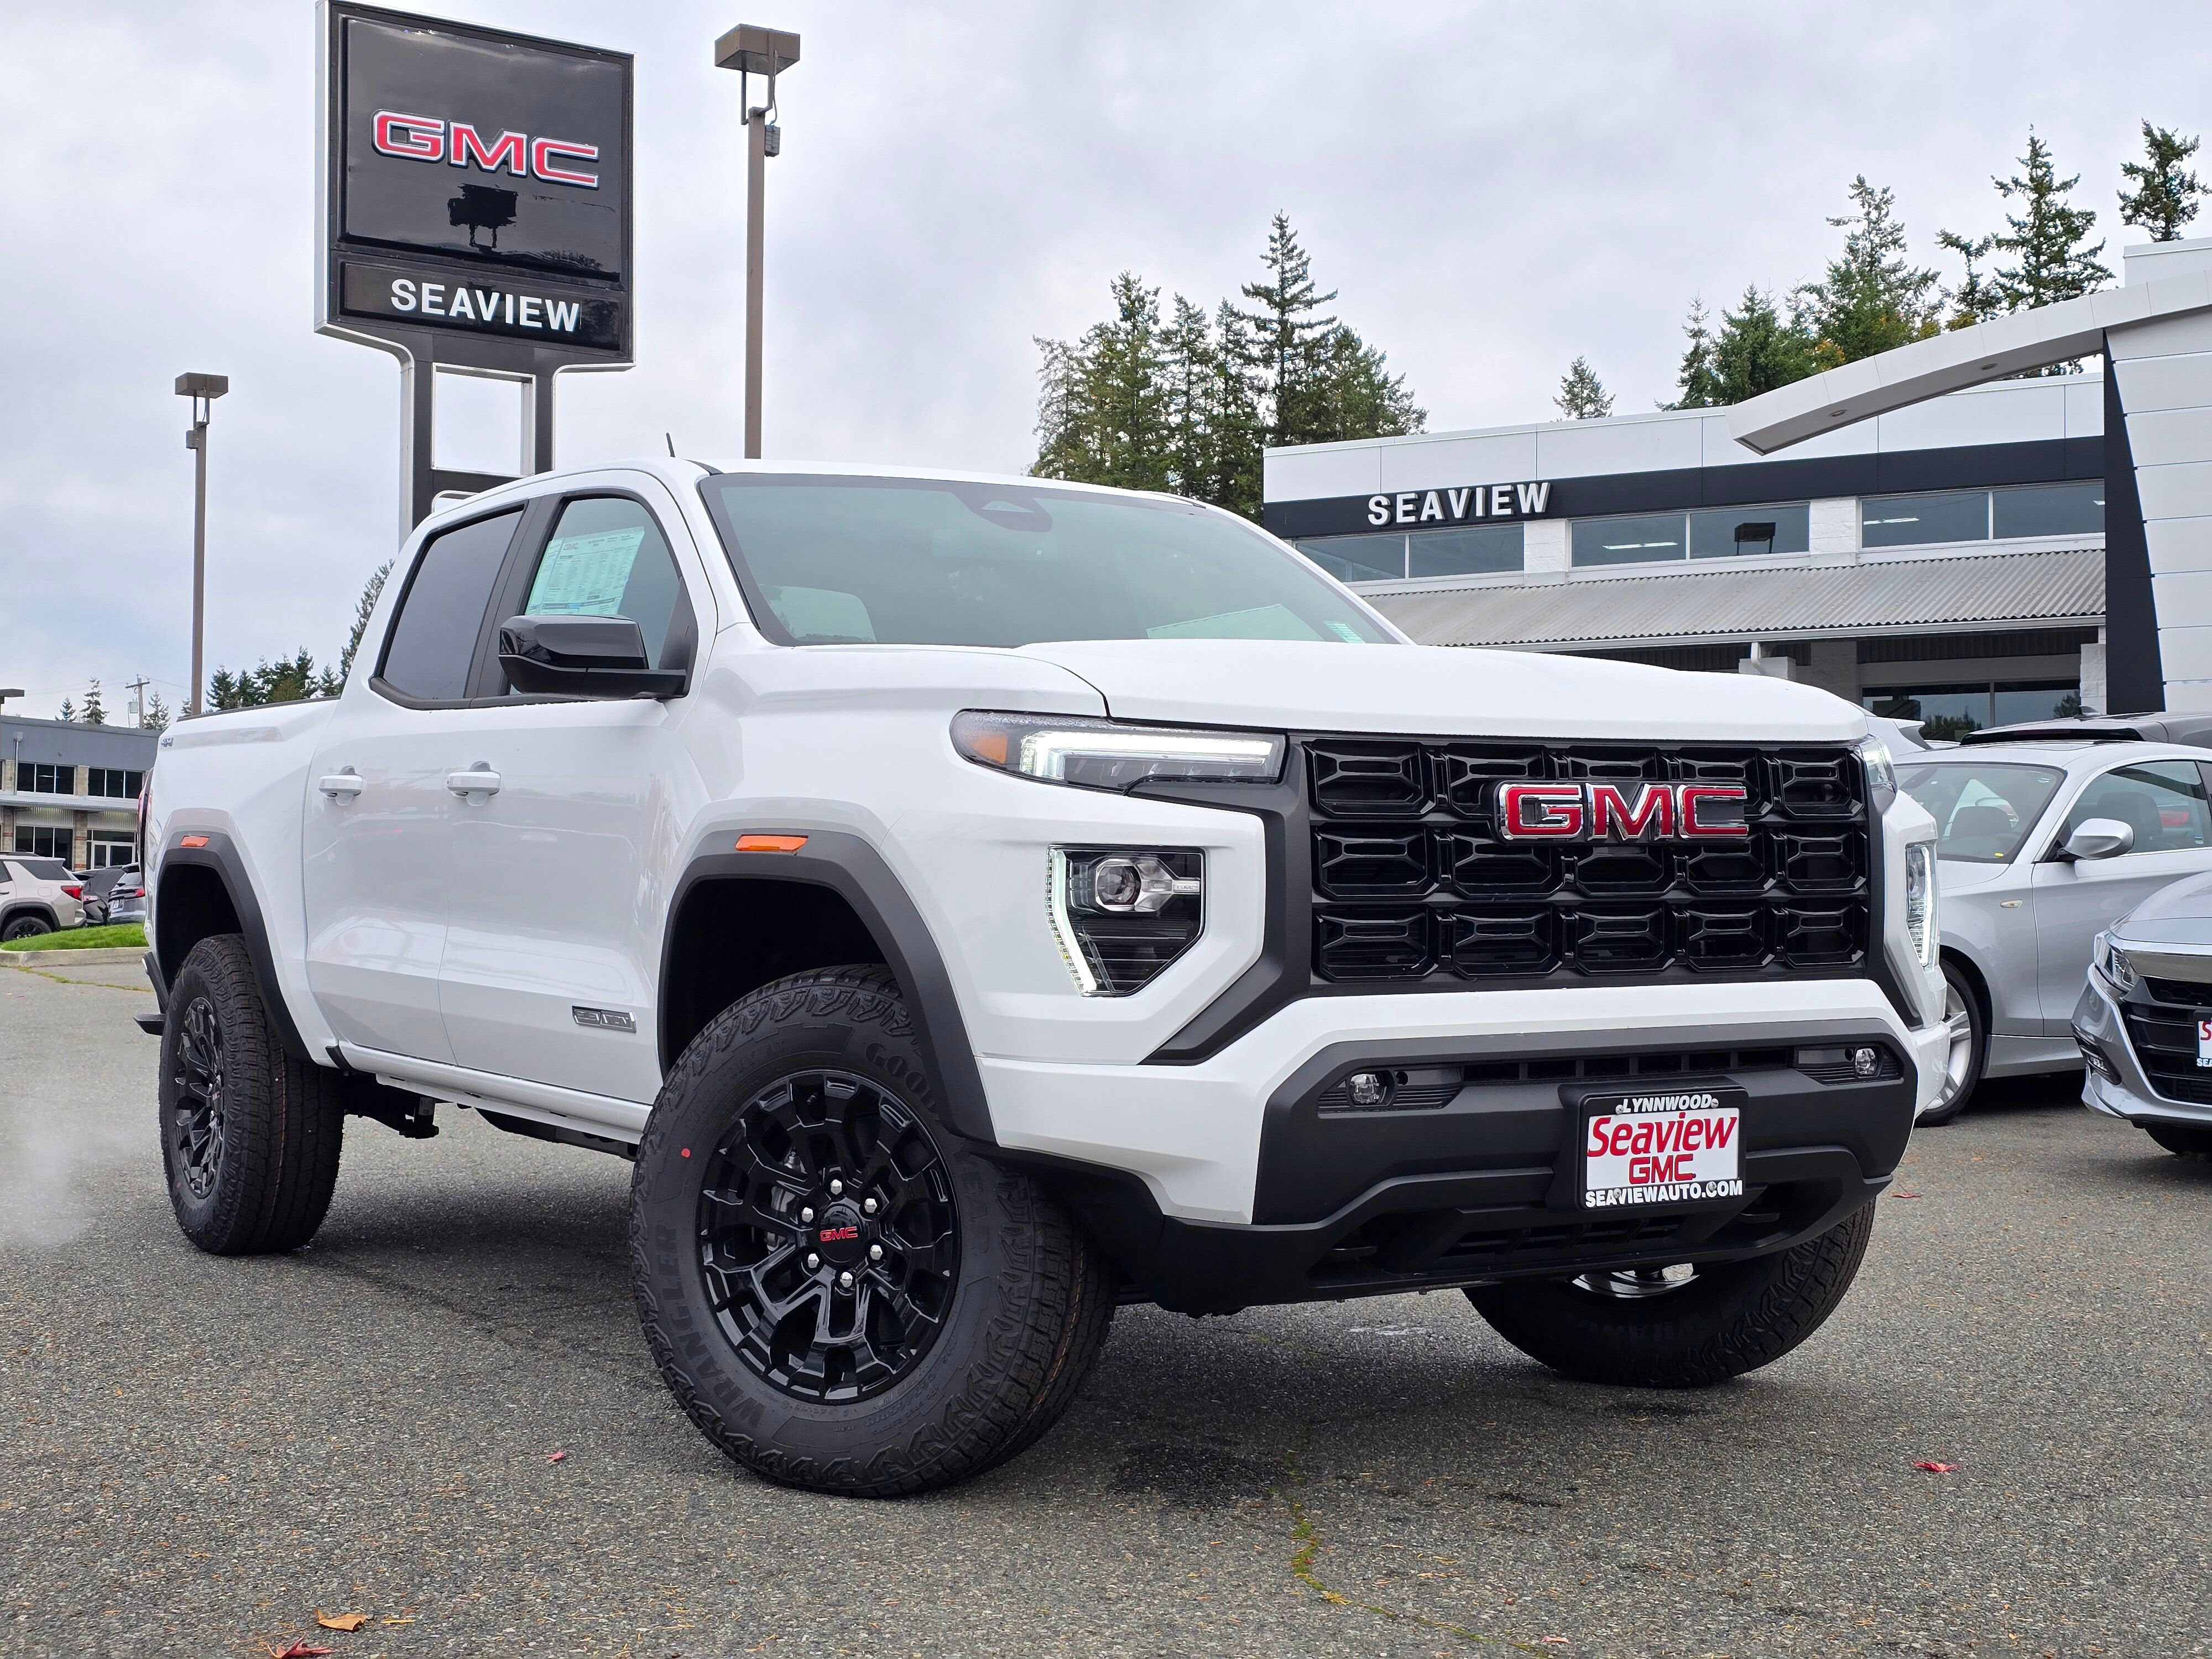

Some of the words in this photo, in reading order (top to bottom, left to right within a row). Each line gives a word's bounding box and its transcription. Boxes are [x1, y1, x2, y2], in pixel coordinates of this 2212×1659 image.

[373, 111, 598, 188] GMC
[391, 279, 580, 332] SEAVIEW
[1368, 483, 1551, 526] SEAVIEW
[1500, 783, 1749, 841] GMC
[1623, 1094, 1712, 1113] LYNNWOOD
[1587, 1112, 1737, 1157] Seaview
[1629, 1154, 1695, 1185] GMC
[1585, 1180, 1743, 1208] SEAVIEWAUTO.COM
[820, 1226, 858, 1241] GMC
